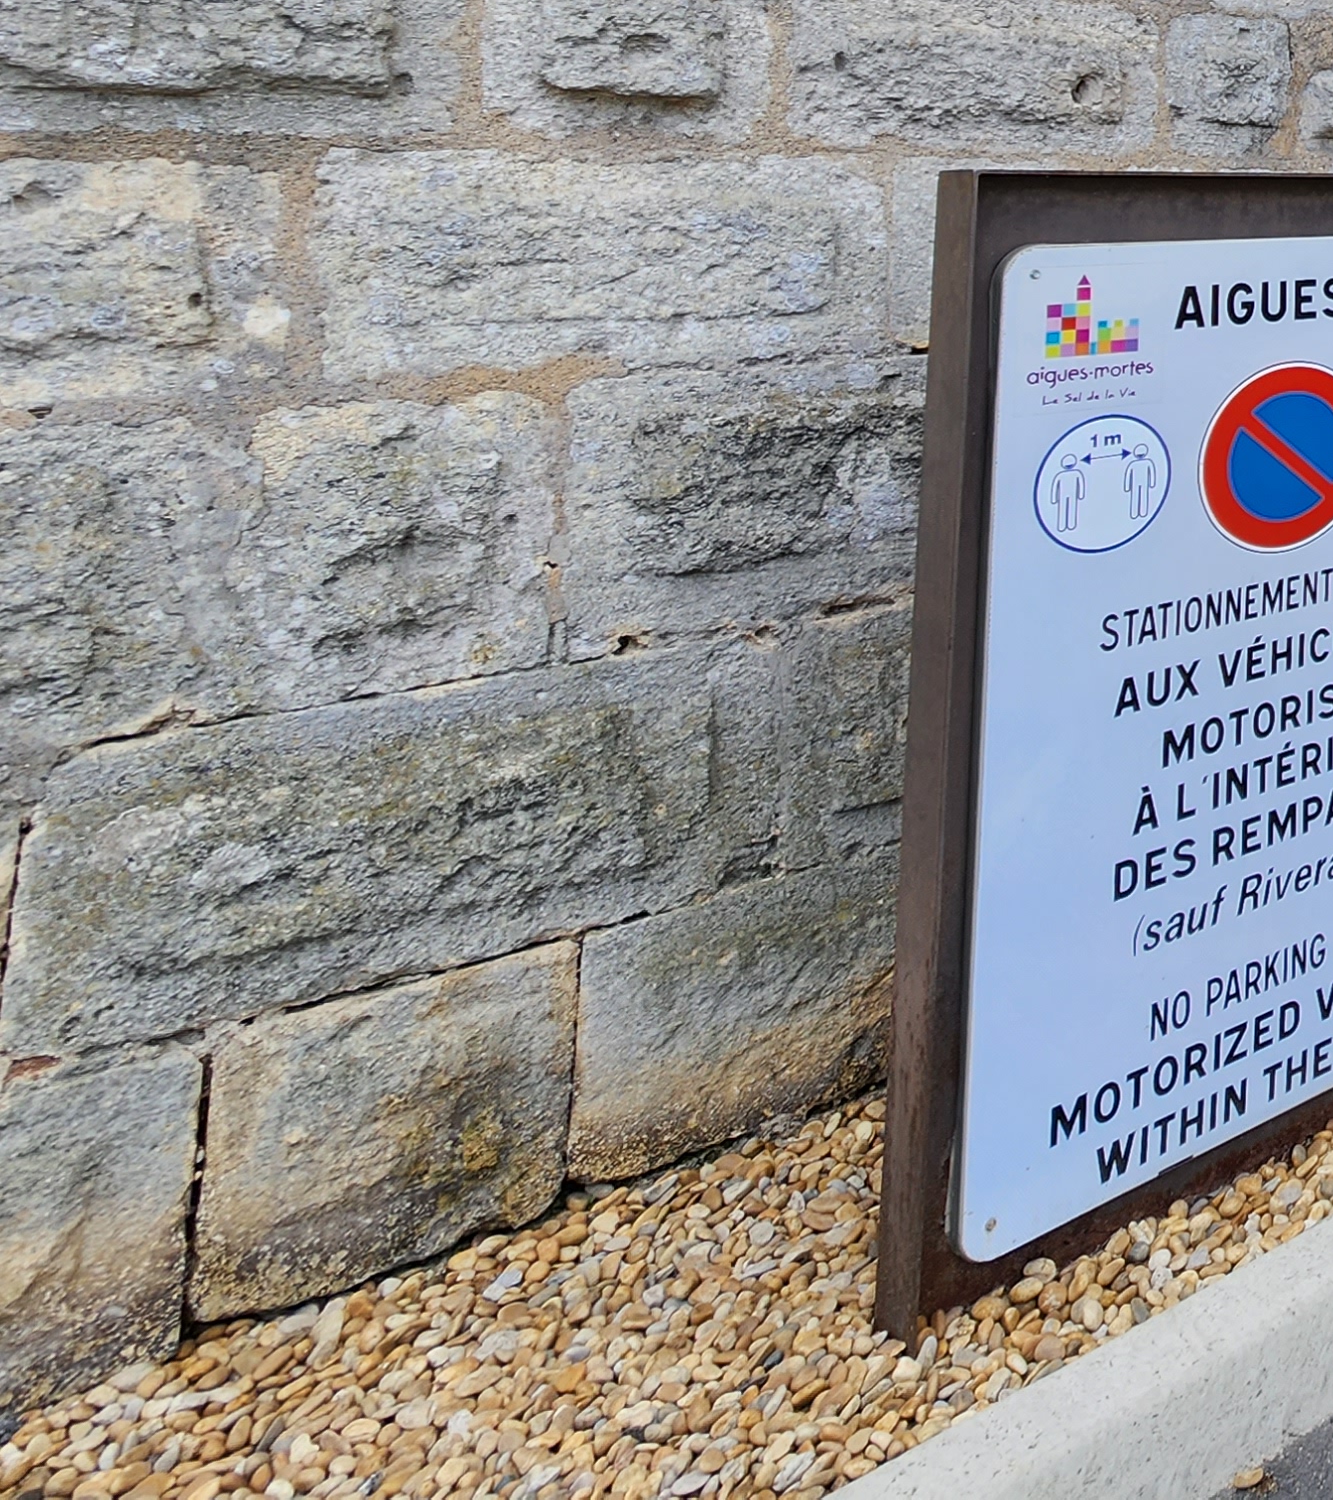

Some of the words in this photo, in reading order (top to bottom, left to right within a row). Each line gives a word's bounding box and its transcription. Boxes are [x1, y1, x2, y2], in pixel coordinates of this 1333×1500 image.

[1027, 361, 1154, 388] aigues-mortes
[1064, 392, 1082, 403] Sel
[1086, 389, 1100, 401] de
[1119, 387, 1136, 398] Vie
[1090, 434, 1098, 447] 1
[1104, 433, 1121, 446] m
[1100, 568, 1333, 651] STATIONNEMENT
[1115, 660, 1200, 717] AUX
[1133, 786, 1158, 835] À
[1114, 839, 1196, 901] DES
[1134, 885, 1227, 956] (sauf
[1151, 991, 1190, 1041] NO
[1207, 934, 1325, 1016] PARKING
[1050, 998, 1299, 1147] MOTORIZED
[1094, 1078, 1247, 1184] WITHIN
[1263, 1038, 1332, 1101] THE
